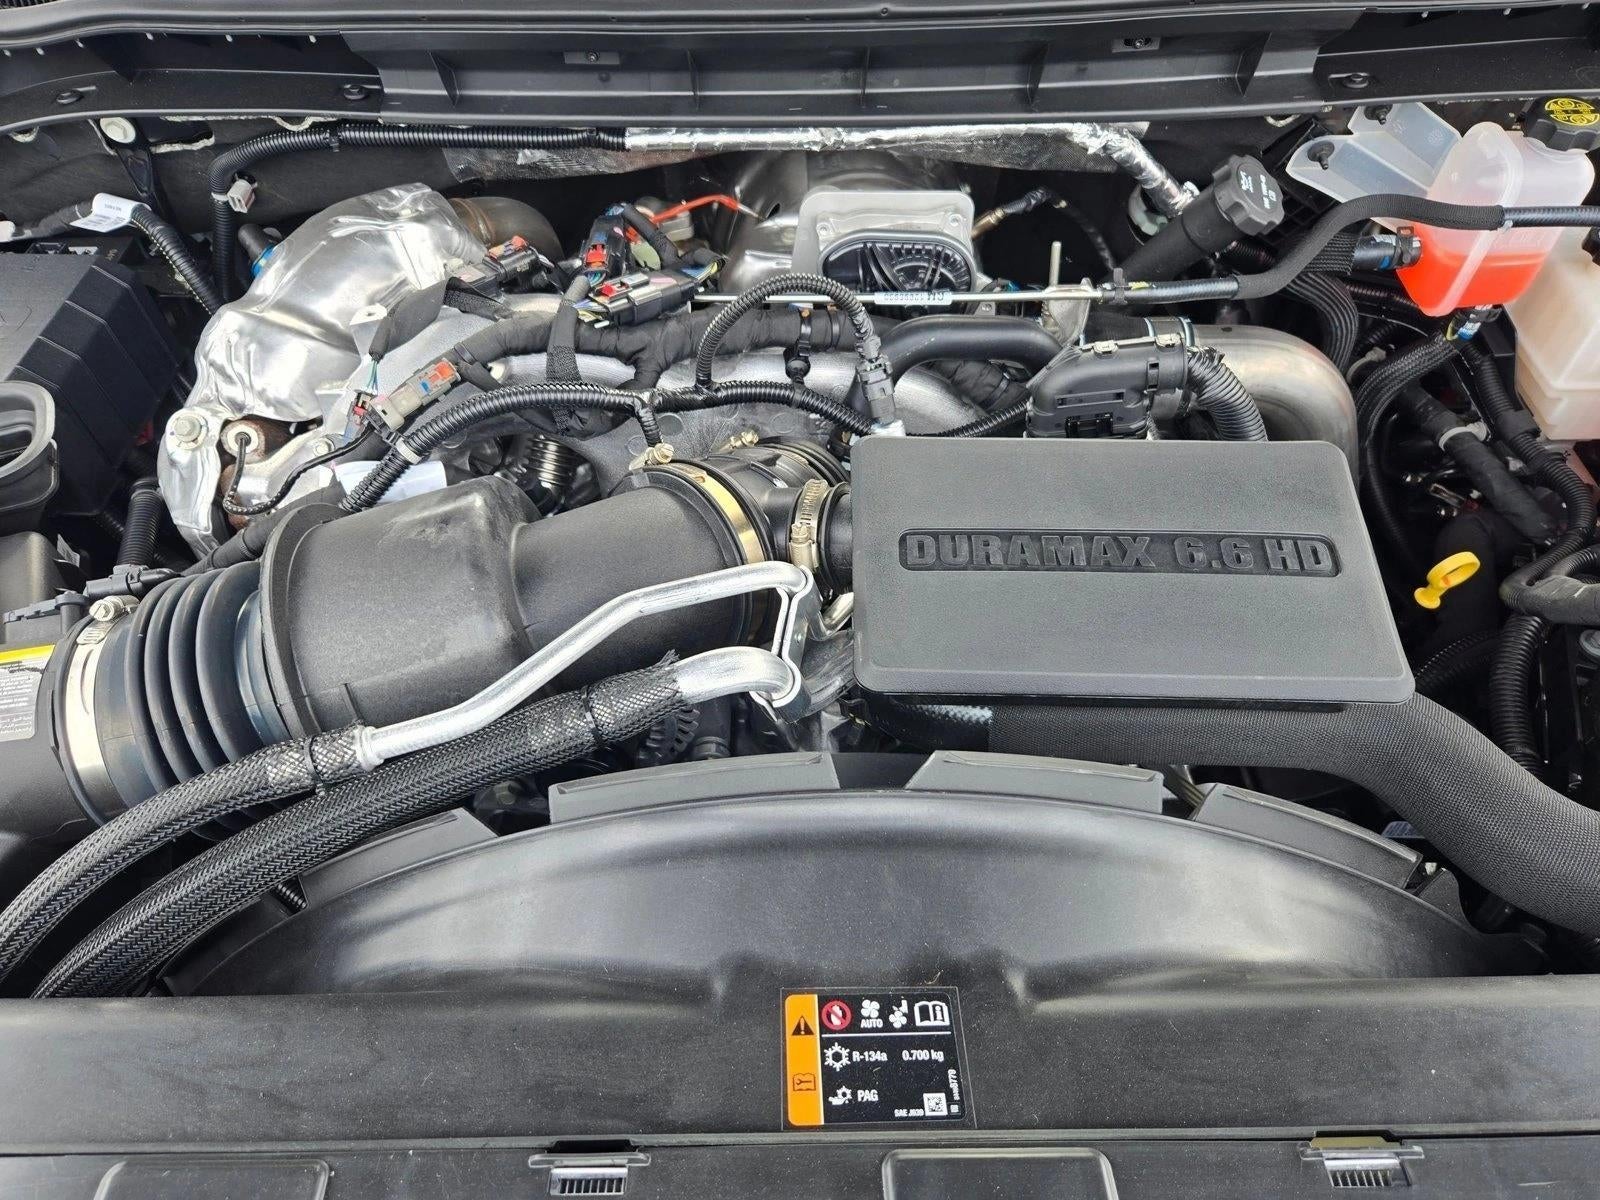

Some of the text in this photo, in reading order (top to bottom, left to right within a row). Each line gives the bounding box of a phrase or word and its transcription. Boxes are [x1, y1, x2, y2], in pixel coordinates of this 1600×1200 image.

[905, 534, 1332, 571] DURAMAX 6.6 HD
[860, 1018, 883, 1028] AUTO
[852, 1050, 944, 1062] R-134a 0.700 kg
[857, 1090, 879, 1102] PAG
